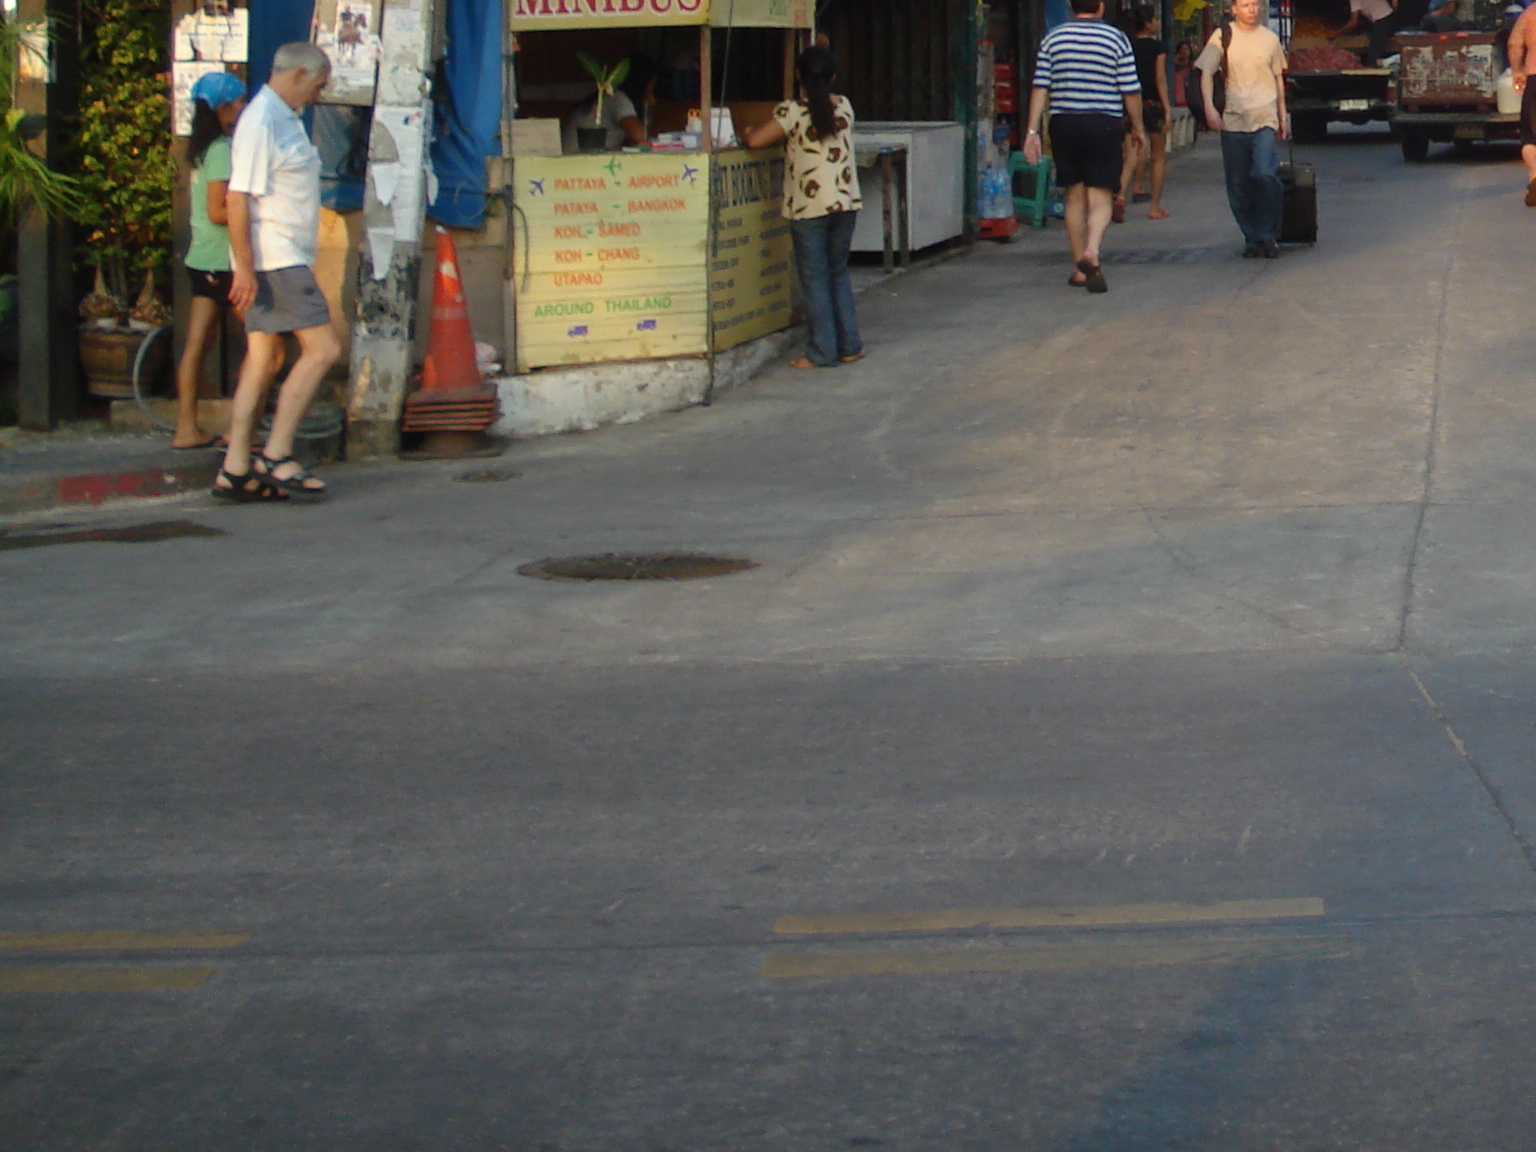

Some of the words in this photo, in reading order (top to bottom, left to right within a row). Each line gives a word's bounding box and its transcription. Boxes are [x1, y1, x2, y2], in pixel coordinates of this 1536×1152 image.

[554, 177, 607, 191] PATTAYA
[628, 174, 680, 188] AIRPORT
[554, 201, 599, 215] PATAYA
[627, 198, 686, 213] BANGKOK
[554, 225, 581, 239] KOH
[598, 222, 641, 237] SAMED
[554, 249, 582, 263] KOH
[597, 246, 640, 261] CHANG
[554, 272, 603, 287] UTAPAO
[534, 301, 595, 317] AROUND
[604, 295, 672, 313] THAILAND
